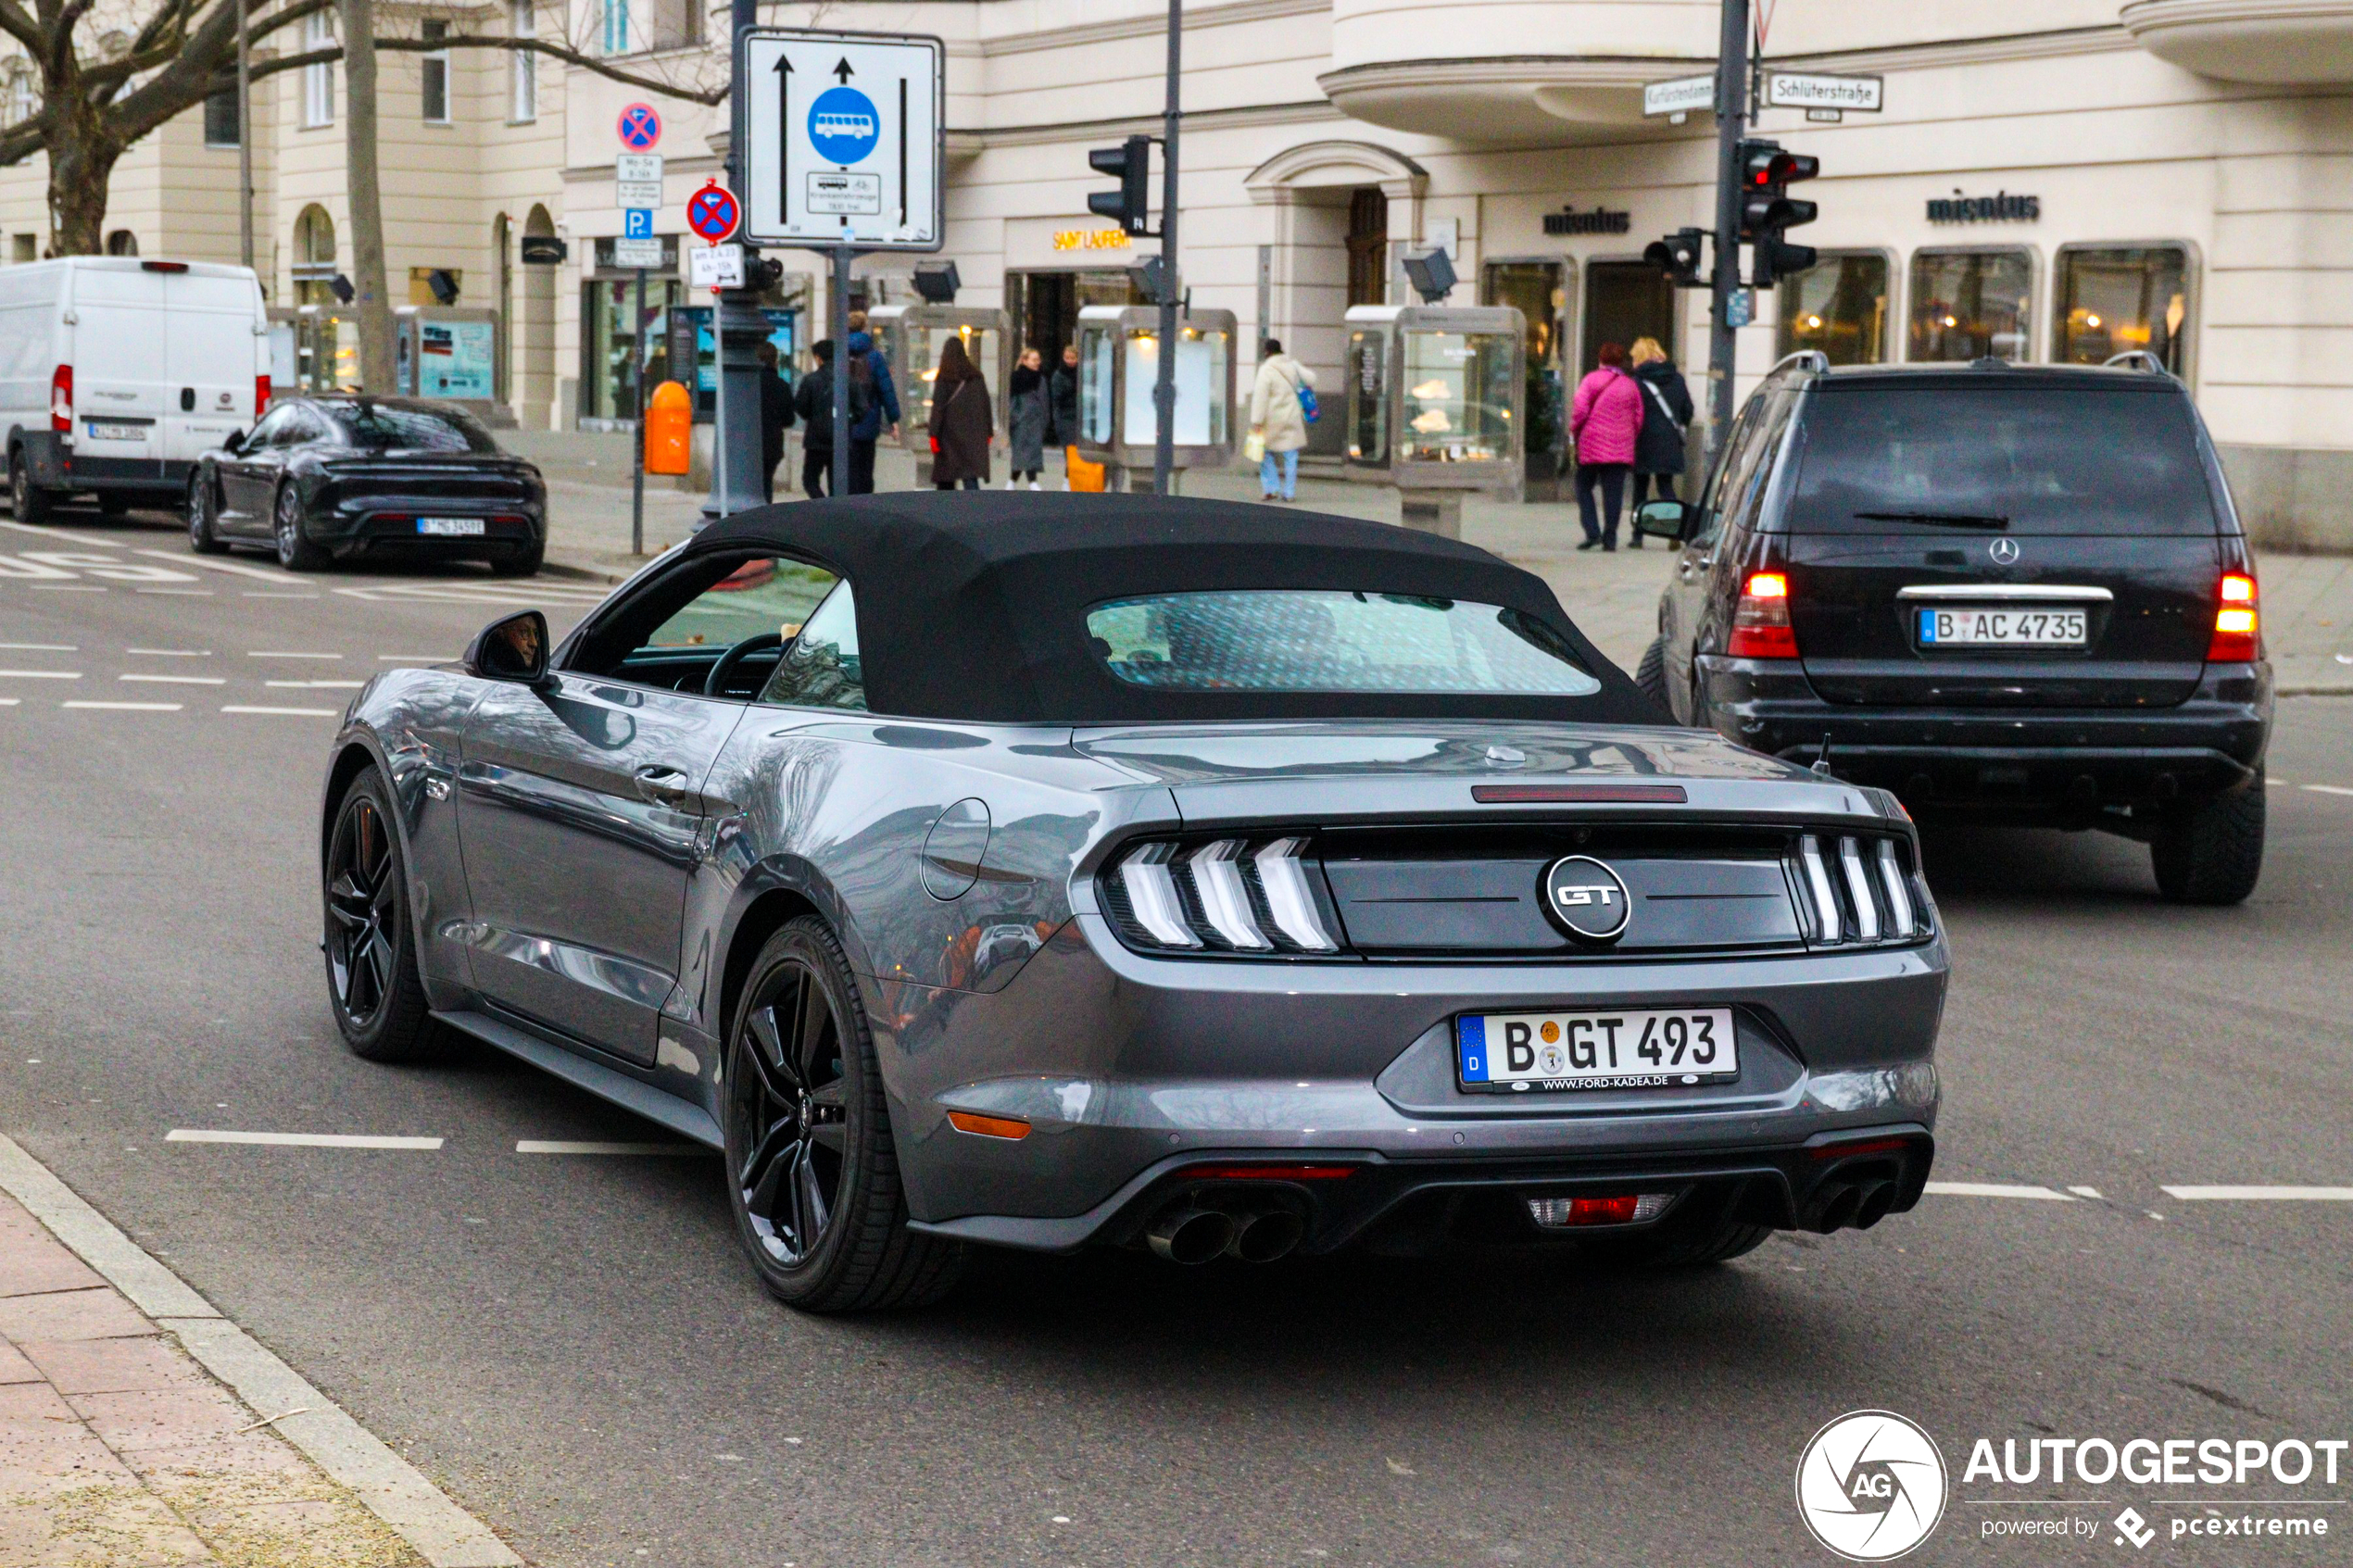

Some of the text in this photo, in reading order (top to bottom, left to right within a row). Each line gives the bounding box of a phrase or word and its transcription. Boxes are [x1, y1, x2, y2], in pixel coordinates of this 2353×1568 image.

[1777, 80, 1872, 104] Schlüterstraße
[1928, 188, 2040, 222] mientus
[1054, 231, 1083, 250] SAINT
[1938, 614, 2082, 640] B AC 4735
[1557, 885, 1619, 905] GT
[1505, 1015, 1716, 1072] B GT 493
[1469, 1056, 1478, 1071] D
[1543, 1076, 1668, 1090] WWW.FORD-KADEA.DE
